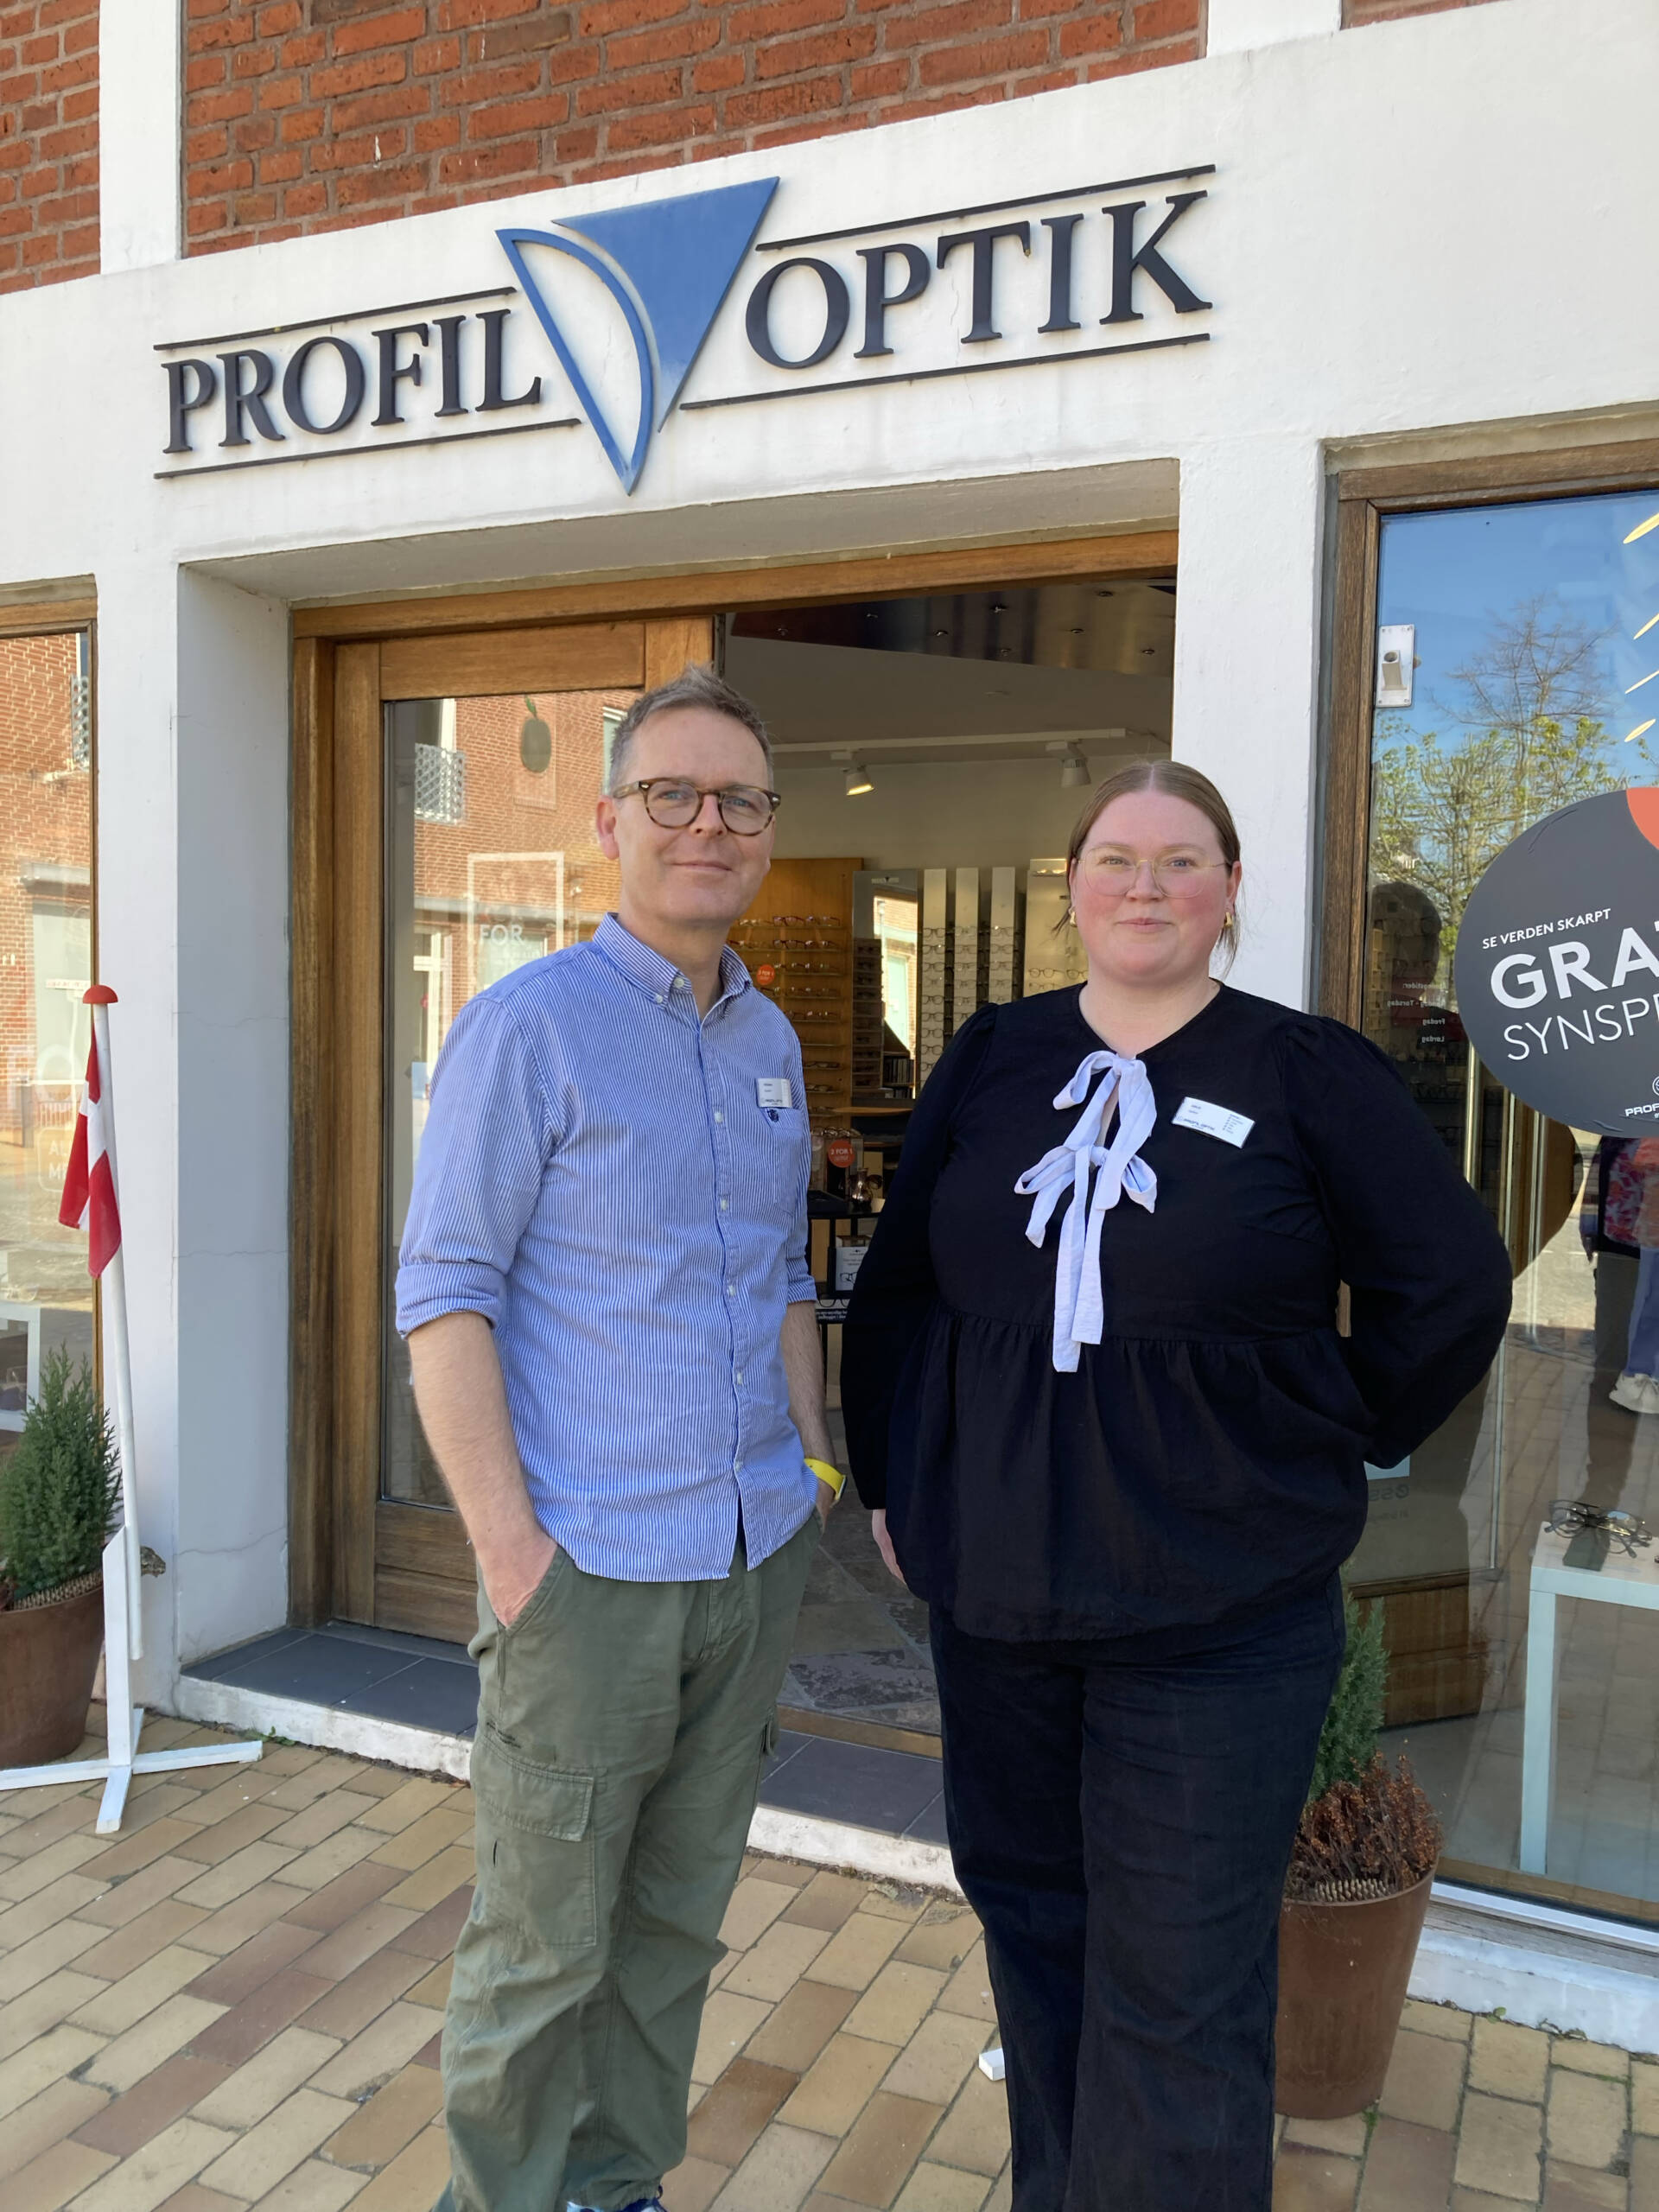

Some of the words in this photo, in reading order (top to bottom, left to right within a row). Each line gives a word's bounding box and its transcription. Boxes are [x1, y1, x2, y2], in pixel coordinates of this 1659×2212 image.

[161, 308, 541, 454] PROFIL
[746, 190, 1213, 369] OPTIK
[480, 924, 524, 946] FOR
[1482, 936, 1497, 950] SE
[1500, 923, 1554, 944] VERDEN
[1557, 908, 1611, 931] SKARPT
[1491, 920, 1659, 1009] GRA
[1503, 993, 1659, 1060] SYNSP
[48, 1141, 67, 1156] AL
